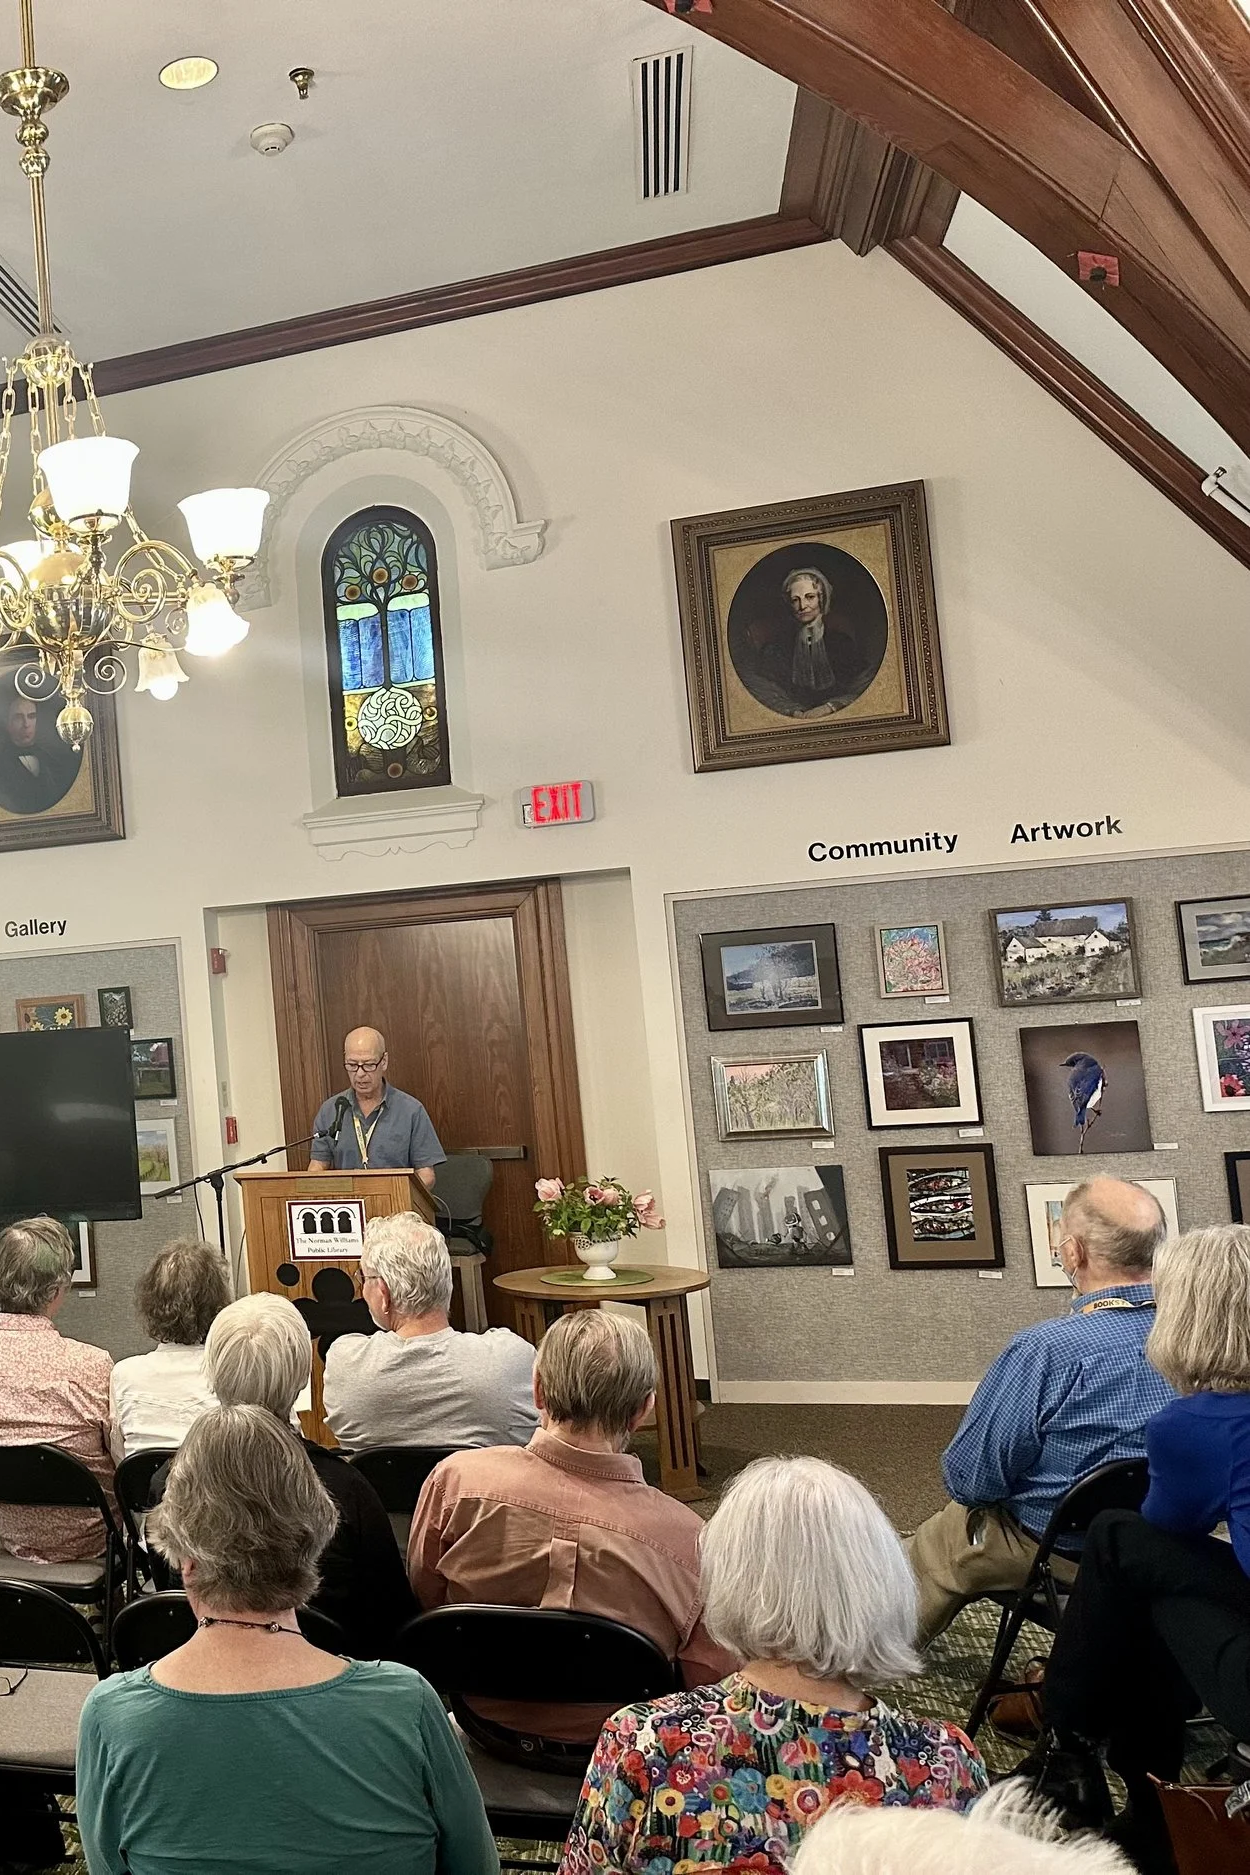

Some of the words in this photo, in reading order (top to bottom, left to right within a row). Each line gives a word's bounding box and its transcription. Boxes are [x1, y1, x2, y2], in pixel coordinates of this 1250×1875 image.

[531, 782, 582, 822] EXIT
[807, 831, 958, 862] Community
[1010, 815, 1123, 844] Artwork
[4, 918, 67, 938] Gallery
